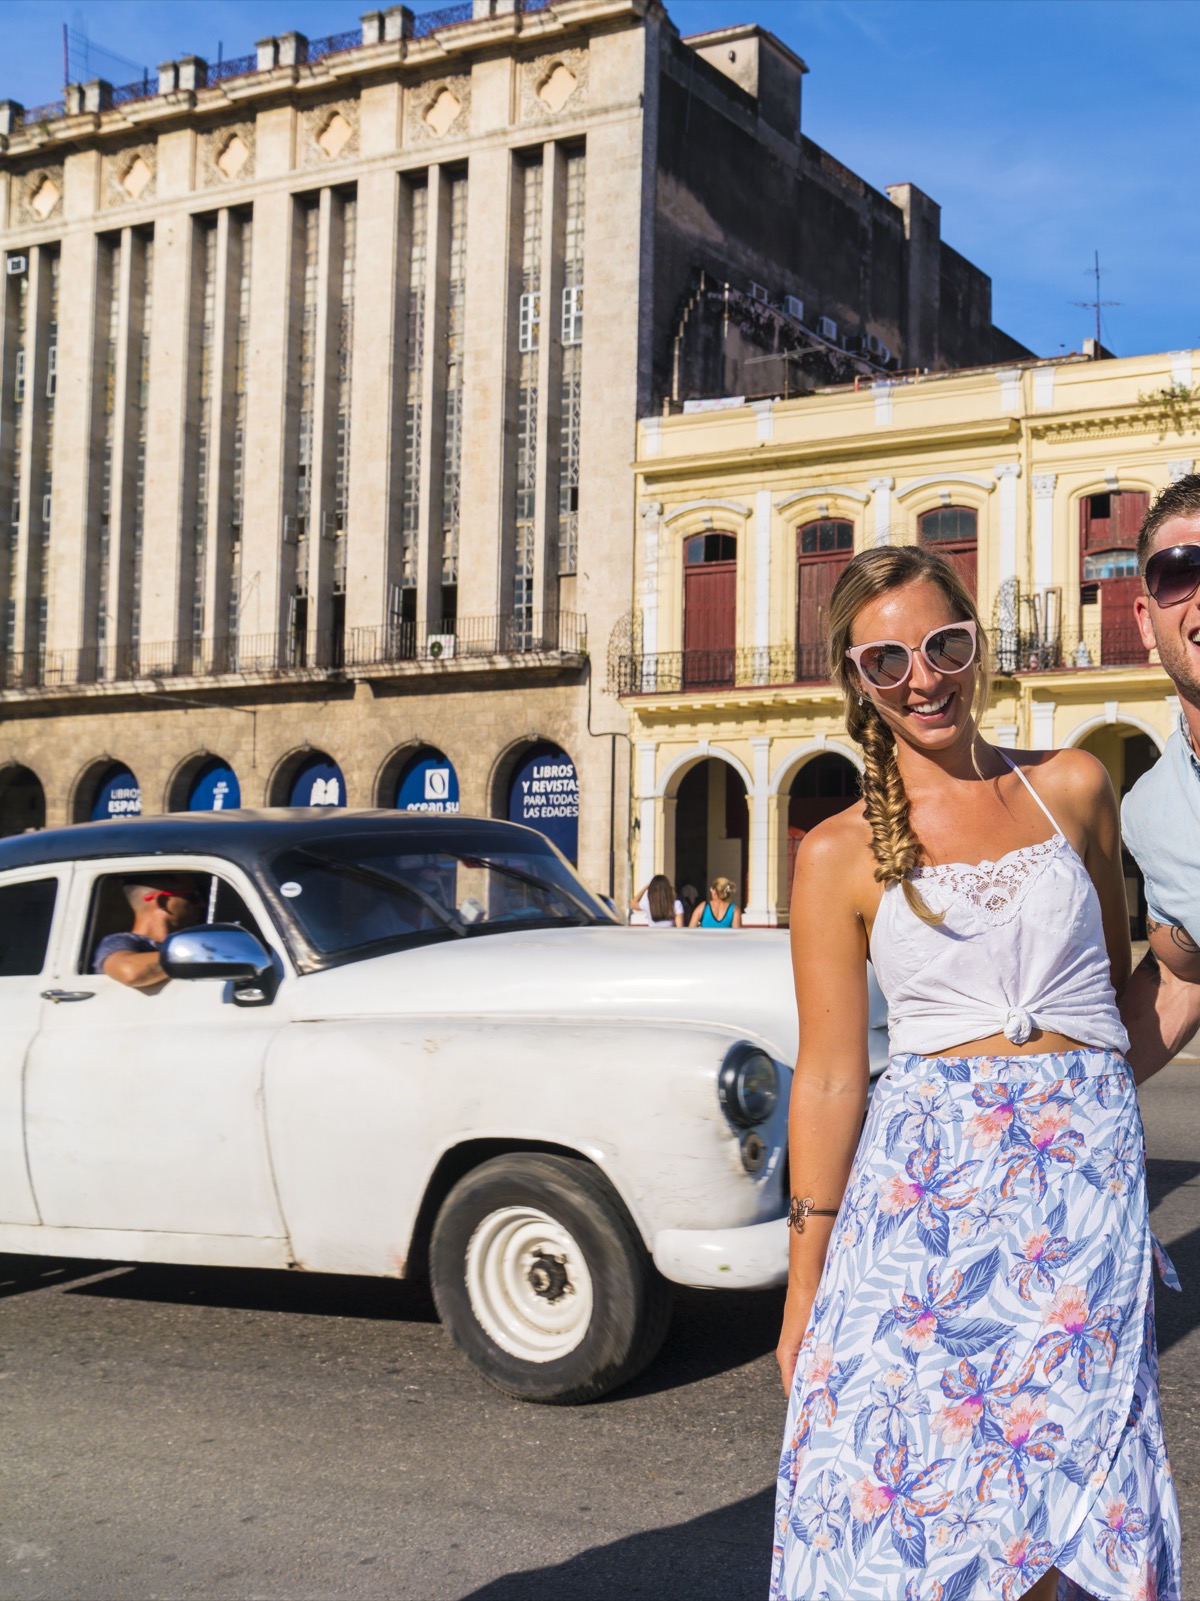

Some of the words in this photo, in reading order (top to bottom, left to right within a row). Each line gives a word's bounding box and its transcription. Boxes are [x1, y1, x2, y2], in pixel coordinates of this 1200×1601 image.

[533, 764, 574, 779] LIBROS
[521, 780, 531, 793] Y
[523, 794, 547, 806] PARA
[548, 793, 580, 805] TODAS
[407, 802, 443, 812] ocean
[523, 806, 540, 818] LAS
[540, 805, 579, 818] EDADES
